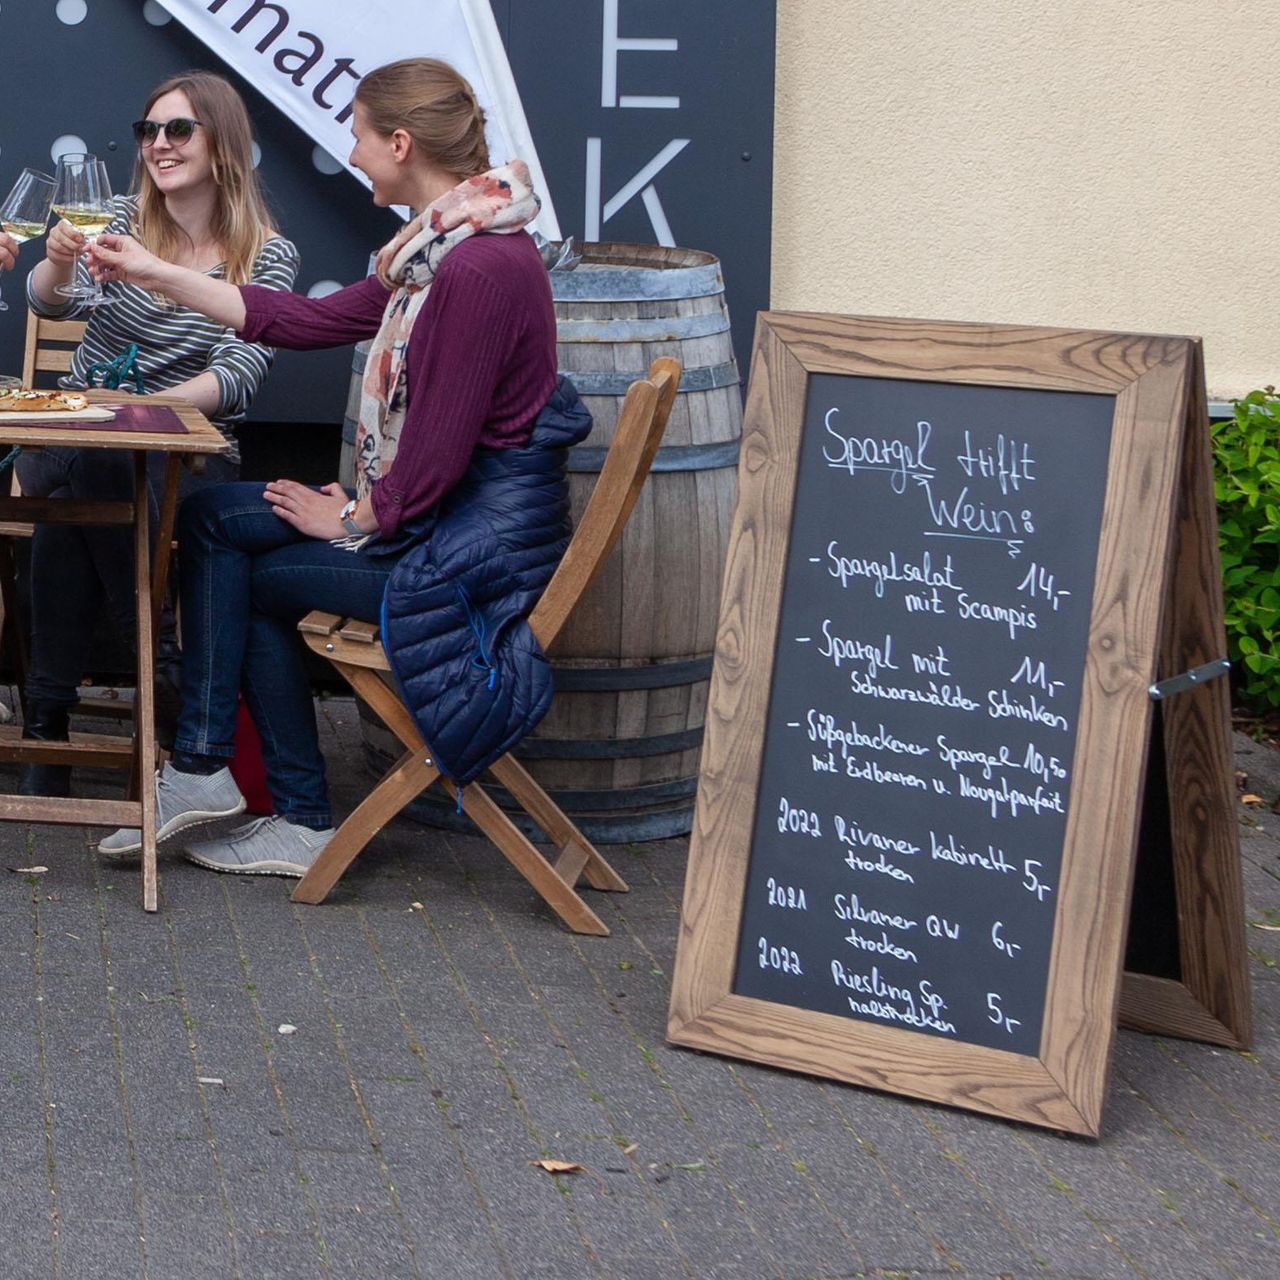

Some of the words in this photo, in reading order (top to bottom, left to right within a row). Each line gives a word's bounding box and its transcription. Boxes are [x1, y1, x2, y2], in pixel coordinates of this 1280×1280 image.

[823, 408, 936, 494] Spargel
[957, 430, 1036, 495] trifft
[827, 540, 963, 598] Spargelsalat
[905, 587, 945, 614] mit
[958, 592, 1037, 640] Scampis
[818, 619, 899, 679] Spargel
[911, 645, 951, 676] mit
[988, 689, 1068, 732] Schinken
[812, 752, 839, 773] mit
[936, 734, 1021, 780] Spargel
[777, 796, 822, 838] 2022
[834, 814, 921, 855] Rivaner
[844, 849, 915, 884] trocken
[767, 877, 807, 911] 2021
[834, 893, 918, 930] Silvaner
[926, 914, 961, 941] QW
[845, 926, 919, 964] trocken
[758, 936, 803, 976] 2022
[831, 959, 913, 1014] Riesling
